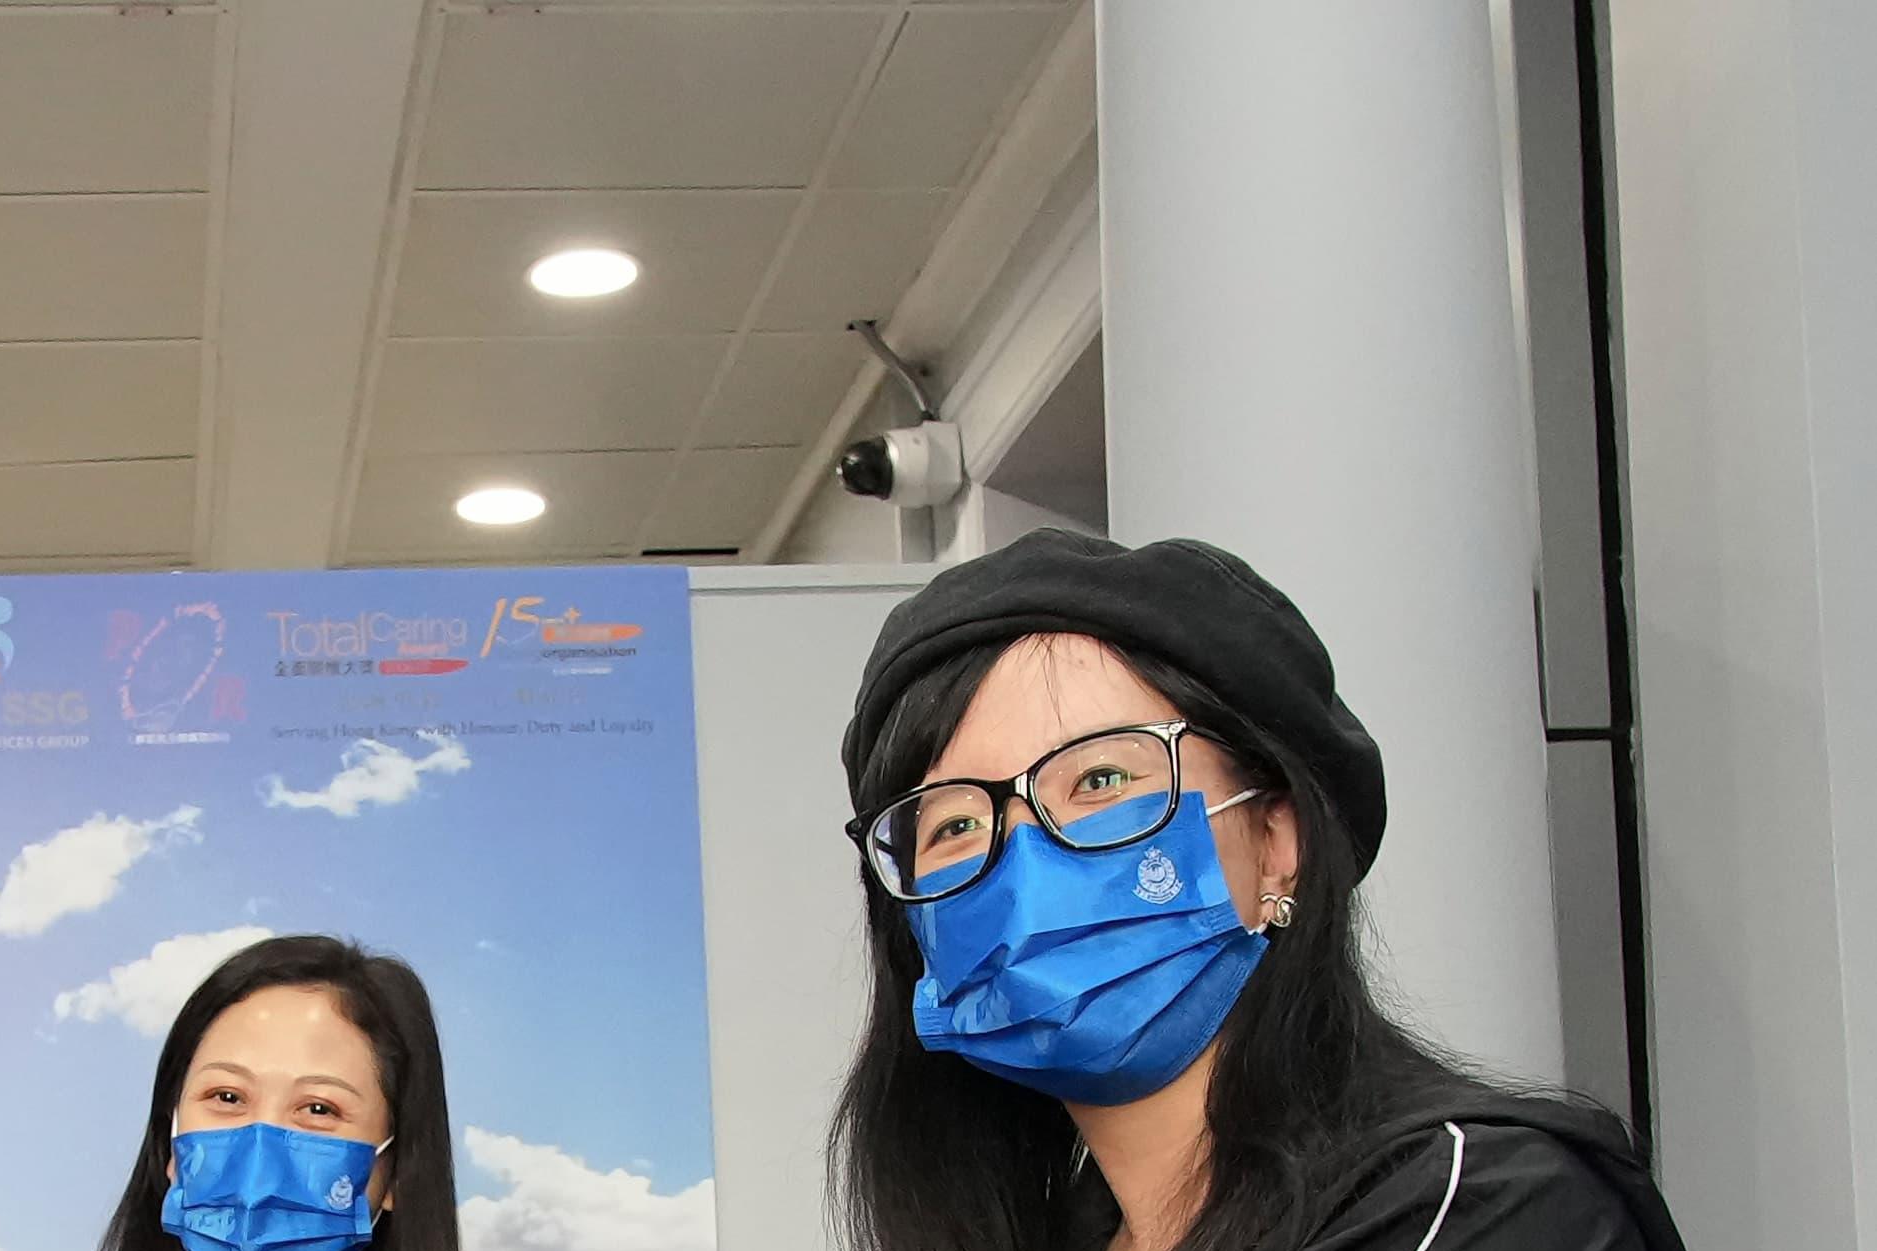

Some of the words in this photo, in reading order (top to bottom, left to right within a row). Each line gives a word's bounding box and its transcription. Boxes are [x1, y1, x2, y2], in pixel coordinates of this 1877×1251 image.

[2, 691, 90, 726] SSG
[333, 722, 374, 739] Hong
[422, 720, 457, 736] with
[36, 734, 91, 749] GROUP
